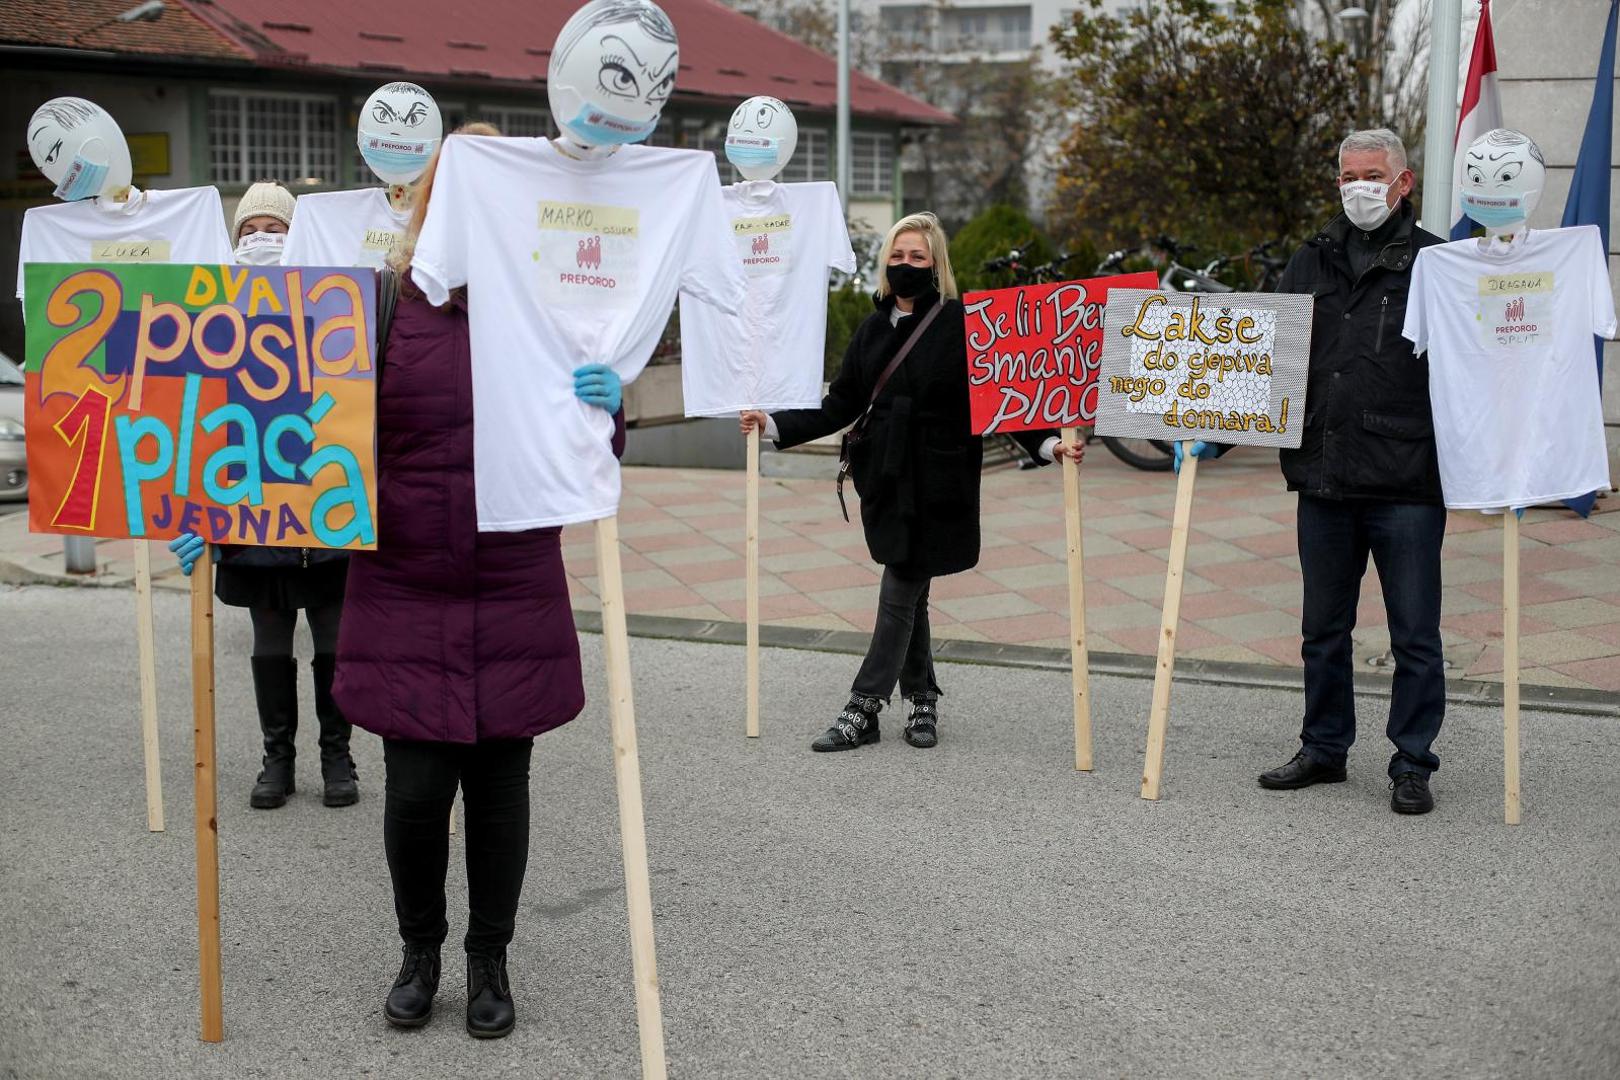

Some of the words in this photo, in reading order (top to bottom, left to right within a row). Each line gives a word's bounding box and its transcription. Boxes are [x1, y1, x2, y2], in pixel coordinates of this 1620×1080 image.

[541, 206, 594, 228] MARKO
[101, 246, 150, 257] LUKA
[743, 256, 780, 265] PREPOROD
[184, 264, 283, 317] DVA
[560, 273, 616, 289] PREPOROD
[1121, 294, 1264, 346] Lakše
[1496, 324, 1538, 334] PREPOROD
[40, 269, 128, 409] 2
[127, 269, 372, 411] posla
[1497, 333, 1541, 345] SPLIT
[1143, 340, 1179, 371] do
[1109, 374, 1167, 402] nego
[1177, 377, 1211, 400] do
[1163, 396, 1290, 434] domara!
[52, 383, 112, 531] 1
[114, 372, 375, 548] plaća
[152, 494, 308, 545] JEDNA
